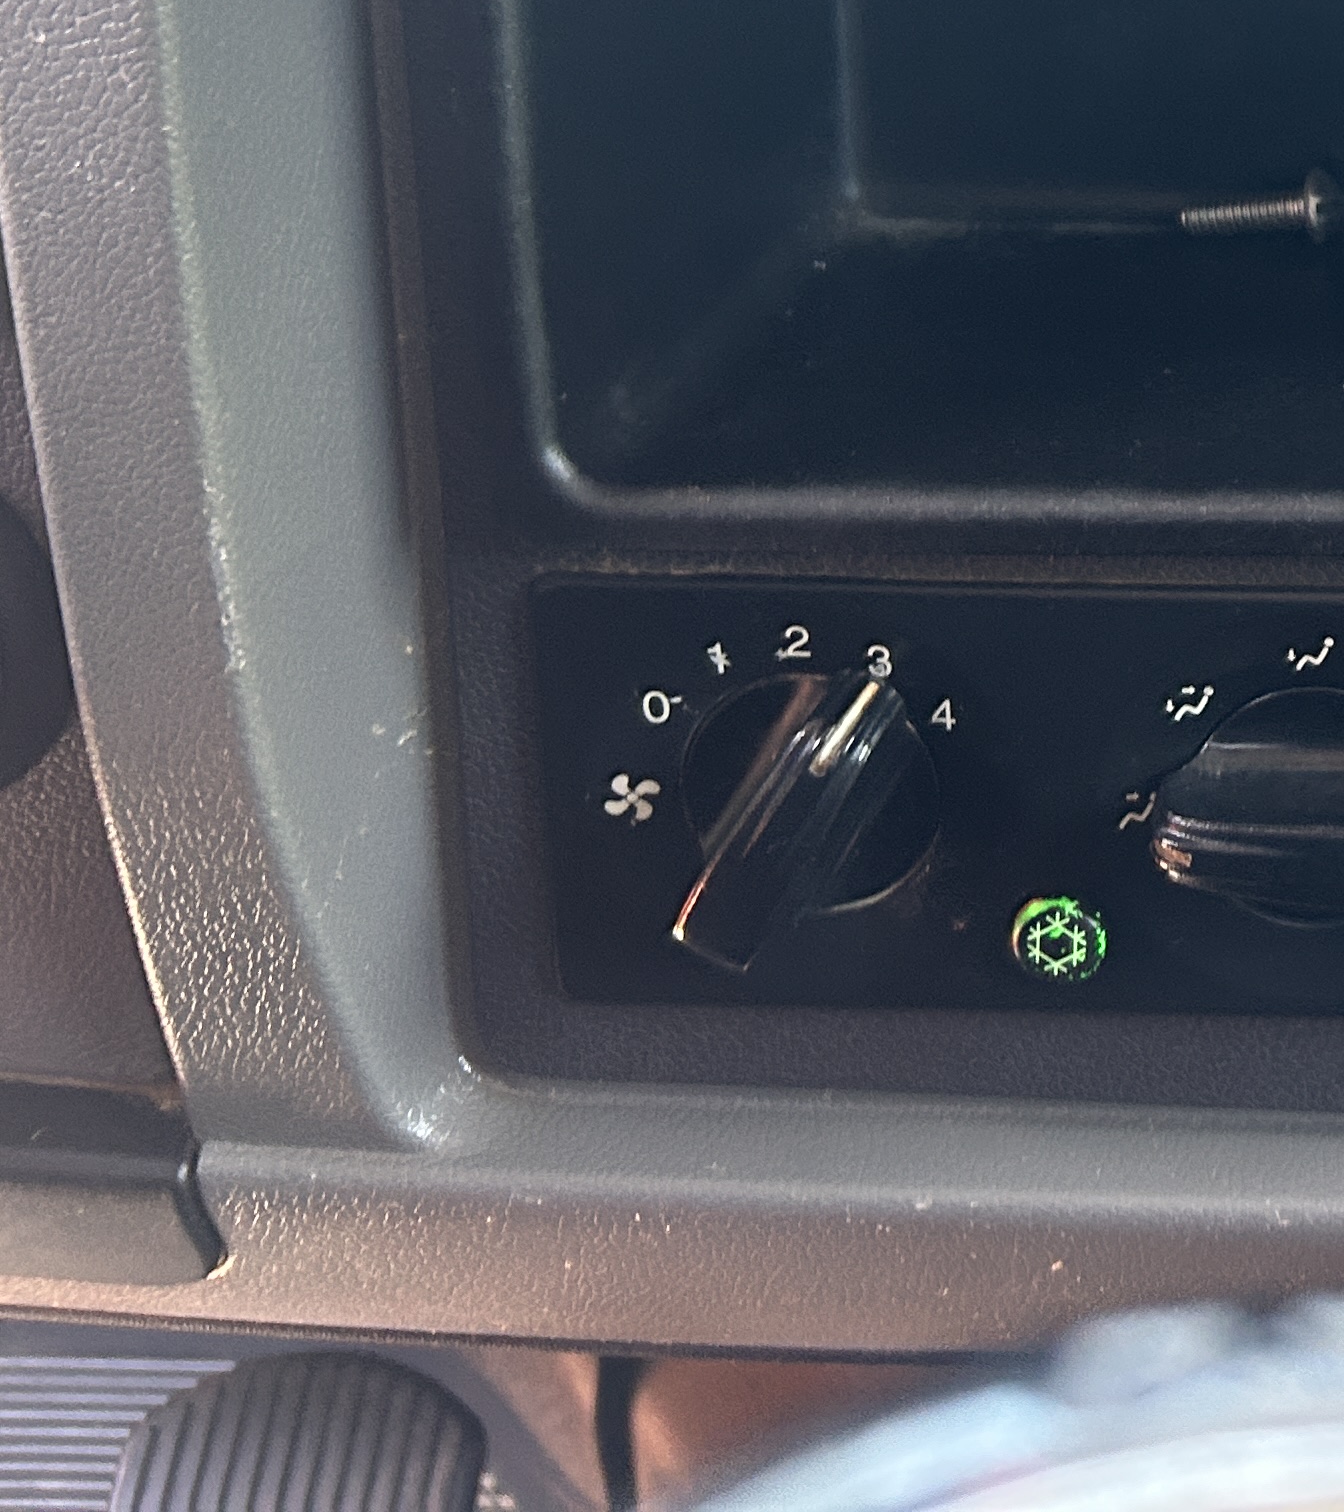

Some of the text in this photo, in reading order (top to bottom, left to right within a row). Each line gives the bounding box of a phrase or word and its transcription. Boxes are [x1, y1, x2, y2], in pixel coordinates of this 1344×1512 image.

[784, 624, 811, 658] 2
[867, 644, 893, 678] 3
[931, 698, 956, 731] 4
